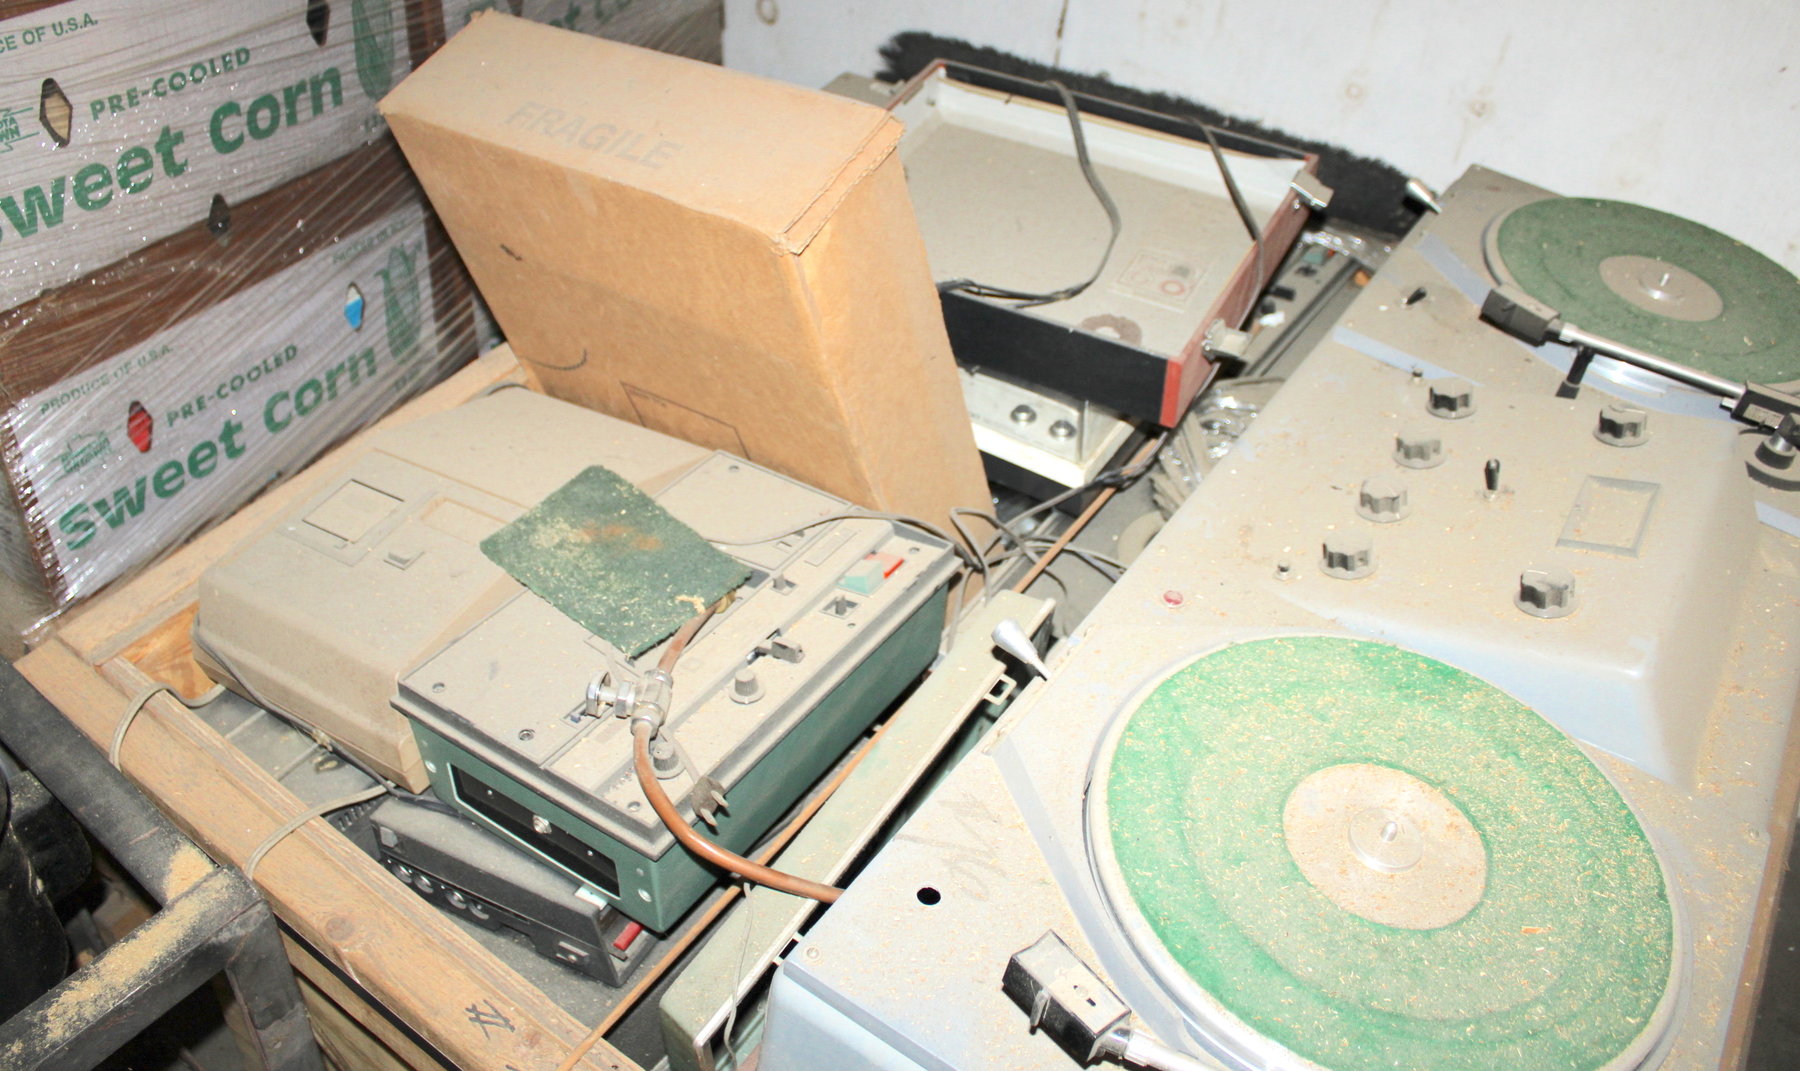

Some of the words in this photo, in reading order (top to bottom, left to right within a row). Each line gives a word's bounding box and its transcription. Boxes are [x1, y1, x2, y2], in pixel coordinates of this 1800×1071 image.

[22, 26, 46, 46] OF
[51, 13, 99, 37] U.S.A.
[90, 47, 251, 122] PRE-COOLED
[0, 125, 189, 243] weet
[209, 67, 343, 154] Corn
[504, 101, 685, 169] FRAGILE
[40, 372, 109, 415] PRODUCE
[113, 360, 132, 380] OF
[166, 344, 297, 428] PRE-COOLED
[59, 419, 247, 551] Sweet
[263, 347, 377, 433] Corn
